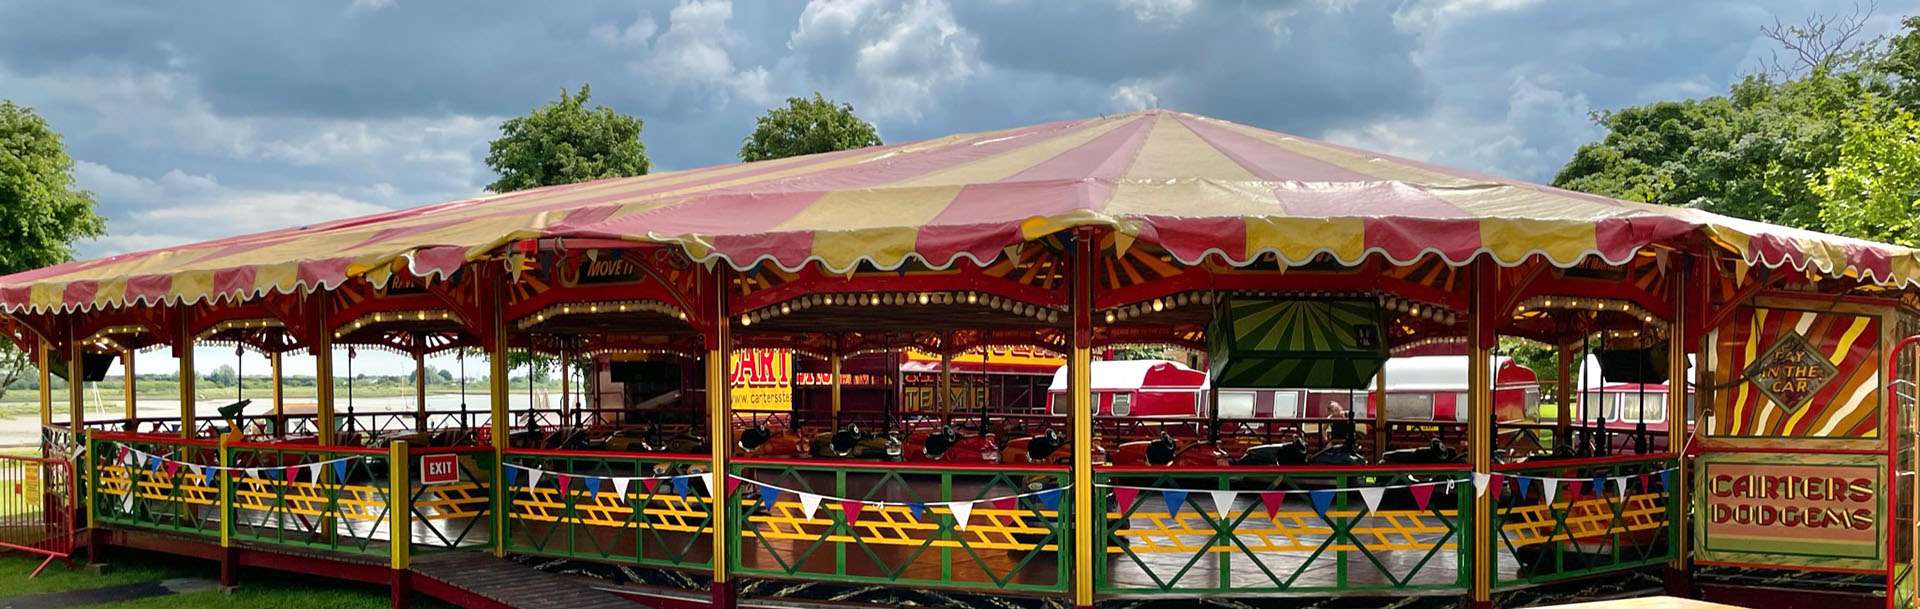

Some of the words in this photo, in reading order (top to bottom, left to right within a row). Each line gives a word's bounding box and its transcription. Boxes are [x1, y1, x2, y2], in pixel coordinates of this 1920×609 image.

[587, 260, 622, 277] MOVE
[1775, 351, 1806, 362] PAY
[1761, 366, 1779, 378] IN
[1786, 365, 1818, 378] THE
[1772, 381, 1807, 393] CAR
[429, 461, 452, 475] EXIT
[1709, 474, 1873, 503] CARTERS
[1711, 503, 1873, 530] DODGEMS
